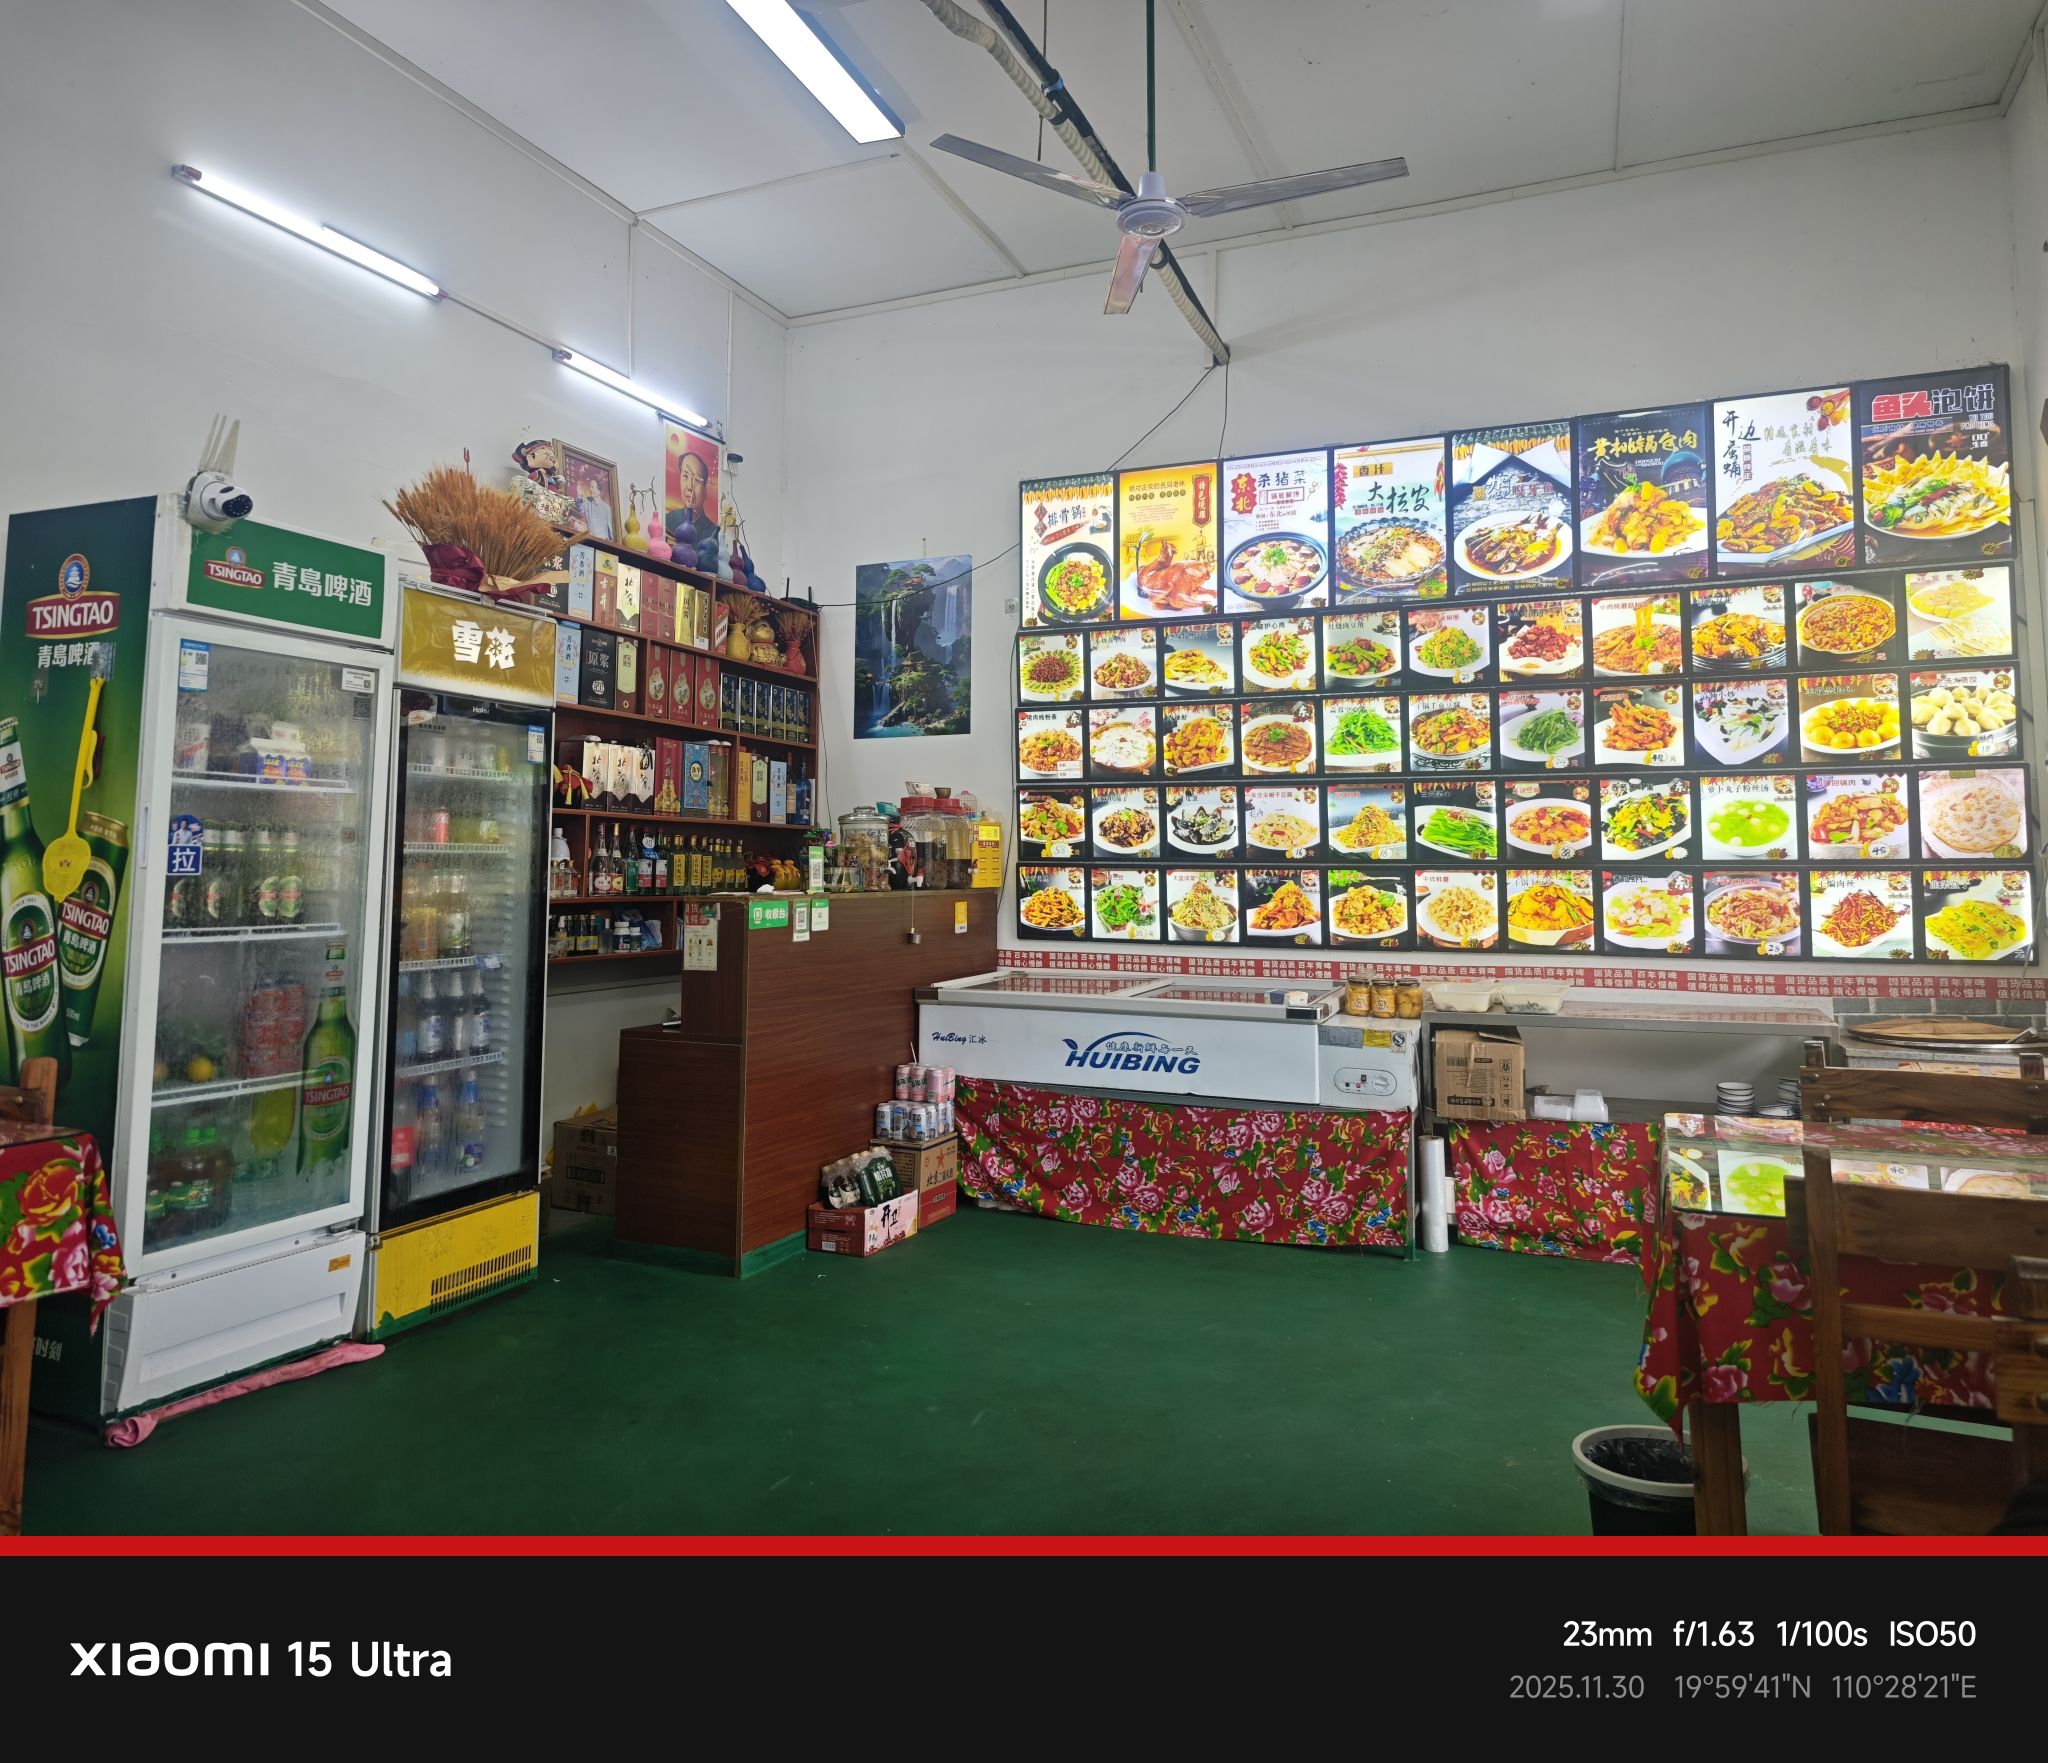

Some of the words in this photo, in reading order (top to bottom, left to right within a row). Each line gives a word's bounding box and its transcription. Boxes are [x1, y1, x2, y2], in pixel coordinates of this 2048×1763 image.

[1872, 384, 1995, 422] 鱼头泡饼
[1258, 470, 1307, 488] 杀猪菜
[1236, 475, 1251, 511] 东北
[1047, 505, 1081, 528] 排骨锅
[208, 563, 262, 585] TSINGTAO
[32, 600, 113, 630] TSINGTAO
[451, 619, 516, 670] 雪花
[589, 652, 609, 668] 原浆
[173, 848, 196, 872] 拉
[1872, 847, 1886, 855] 45
[62, 902, 110, 935] TSINGTAO
[765, 907, 786, 920] 收银台
[4, 939, 55, 973] TSINGTAO
[1014, 952, 1043, 960] 百年青啤
[1049, 953, 1078, 961] 国货品质
[1081, 954, 1111, 962] 百年青啤
[1117, 955, 1148, 963] 国货品质
[1150, 956, 1181, 965] 百年青啤
[1189, 958, 1219, 966] 国货品质
[1223, 959, 1254, 967] 百年青啤
[1262, 960, 1295, 969] 国货品质
[1298, 961, 1332, 970] 百年青啤
[1420, 966, 1455, 975] 国货品质
[1459, 967, 1495, 976] 百年青啤
[1505, 967, 1541, 976] 国货品质
[1546, 968, 1584, 977] 百年青啤
[1594, 969, 1633, 978] 国货品质
[1637, 970, 1678, 979] 百年青啤
[1687, 972, 1728, 981] 国货品质
[1733, 975, 1775, 984] 百年青啤
[1786, 976, 1829, 985] 国货品质
[1833, 977, 1877, 986] 百年青啤
[1888, 978, 1934, 987] 国货品质
[1939, 978, 1985, 988] 百年青啤
[932, 1032, 967, 1045] HuiBing
[968, 1034, 987, 1045] 汇冰
[1106, 1041, 1199, 1055] 健康新鲜每一天
[1065, 1051, 1200, 1074] HUIBING
[305, 1085, 350, 1103] TSINGTAO
[33, 1337, 63, 1361] 时刻
